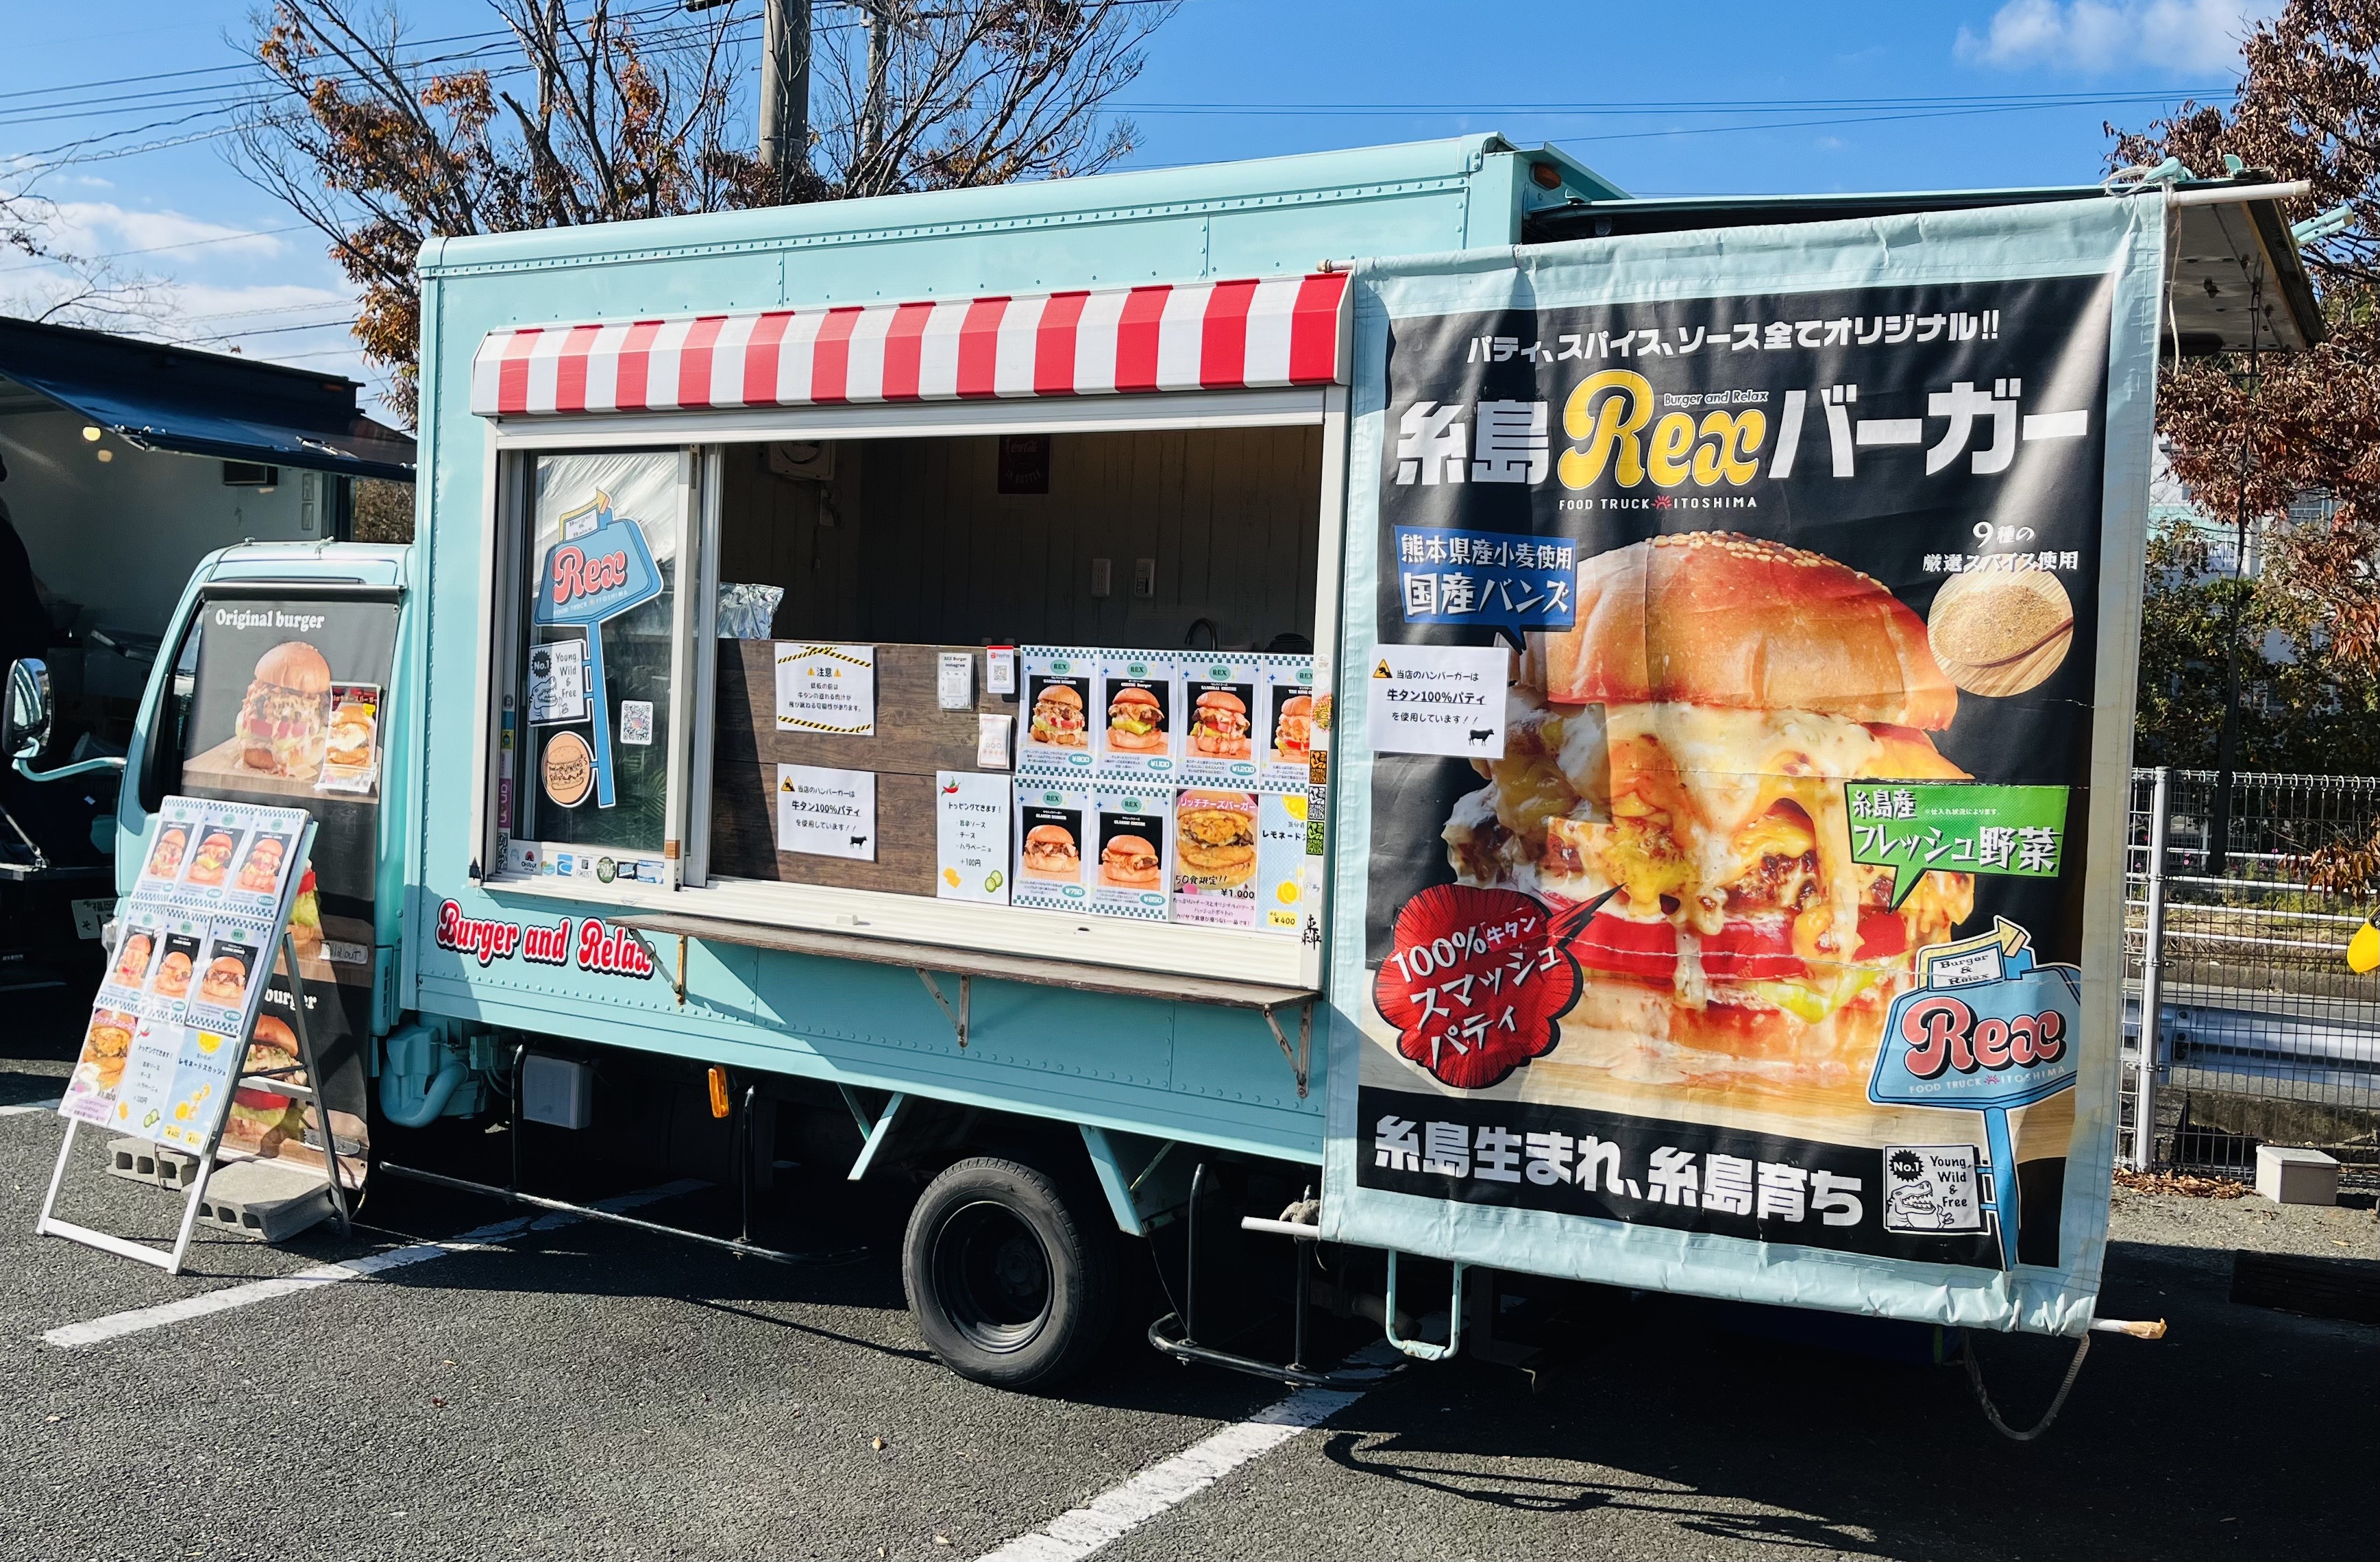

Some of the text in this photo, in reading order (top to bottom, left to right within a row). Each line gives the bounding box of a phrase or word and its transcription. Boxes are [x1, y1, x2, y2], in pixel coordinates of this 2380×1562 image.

[1664, 389, 1769, 408] Burger and Relax
[1396, 369, 2088, 490] 糸島 Rex バーガー
[1558, 497, 1757, 510] FOOD TRUCK ITOSHIMA
[569, 514, 592, 527] Burger
[1972, 521, 2036, 548] 9種の
[1401, 533, 1573, 571] 熊本県産小麦使用
[1922, 550, 2079, 574] 厳選スパイス使用
[551, 545, 628, 605] Rex
[554, 590, 628, 616] FOOD TRUCK ITOSHIMA
[1404, 572, 1571, 617] 国産バンズ
[215, 609, 326, 632] Original burger
[534, 661, 550, 670] No.1
[556, 652, 580, 663] Young,
[560, 666, 576, 676] Wild
[817, 667, 832, 677] 注意
[1396, 670, 1480, 681] 当店のハンバーガーは
[562, 690, 576, 698] Free
[1386, 688, 1486, 705] 牛タン100%パティ
[792, 800, 860, 816] 牛タン100%パティ
[1180, 797, 1257, 811] リッチチーズバーガー
[1852, 788, 1917, 819] 糸島産
[1852, 824, 2063, 871] フレッシュ野菜
[437, 899, 520, 964] Burger
[524, 918, 572, 964] and
[1939, 955, 1989, 968] Burger
[1961, 966, 1972, 974] &
[1948, 973, 1990, 985] Relax
[1410, 946, 1561, 1031] スマッシュ
[1430, 1005, 1516, 1070] パティ
[1901, 997, 2064, 1078] Rex
[1909, 1065, 2066, 1094] FOOD TRUCK ITOSHIMA
[1375, 1114, 1863, 1227] 糸島生まれ、糸島育ち
[1892, 1156, 1972, 1174] No.1 Young,
[1937, 1170, 1967, 1184] Wild
[1949, 1184, 1958, 1195] &
[1942, 1195, 1968, 1208] Free
